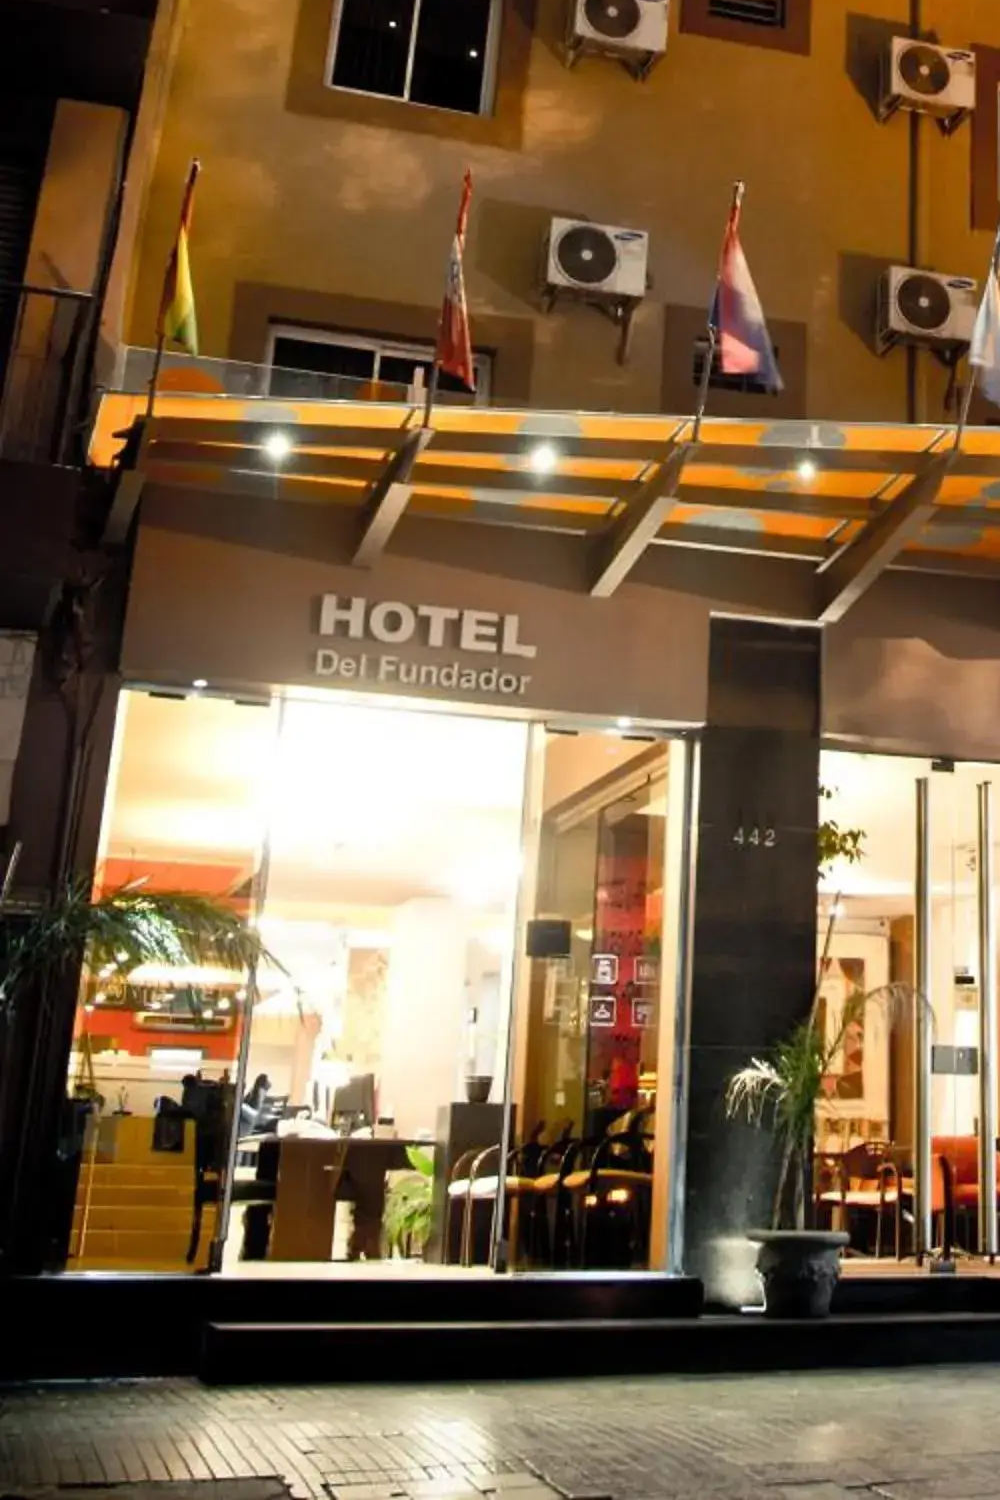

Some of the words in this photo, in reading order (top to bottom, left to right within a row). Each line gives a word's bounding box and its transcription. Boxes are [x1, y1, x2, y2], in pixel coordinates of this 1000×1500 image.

[318, 593, 538, 658] HOTEL
[315, 648, 368, 678] Del
[379, 655, 532, 694] Fundador
[733, 827, 776, 847] 442
